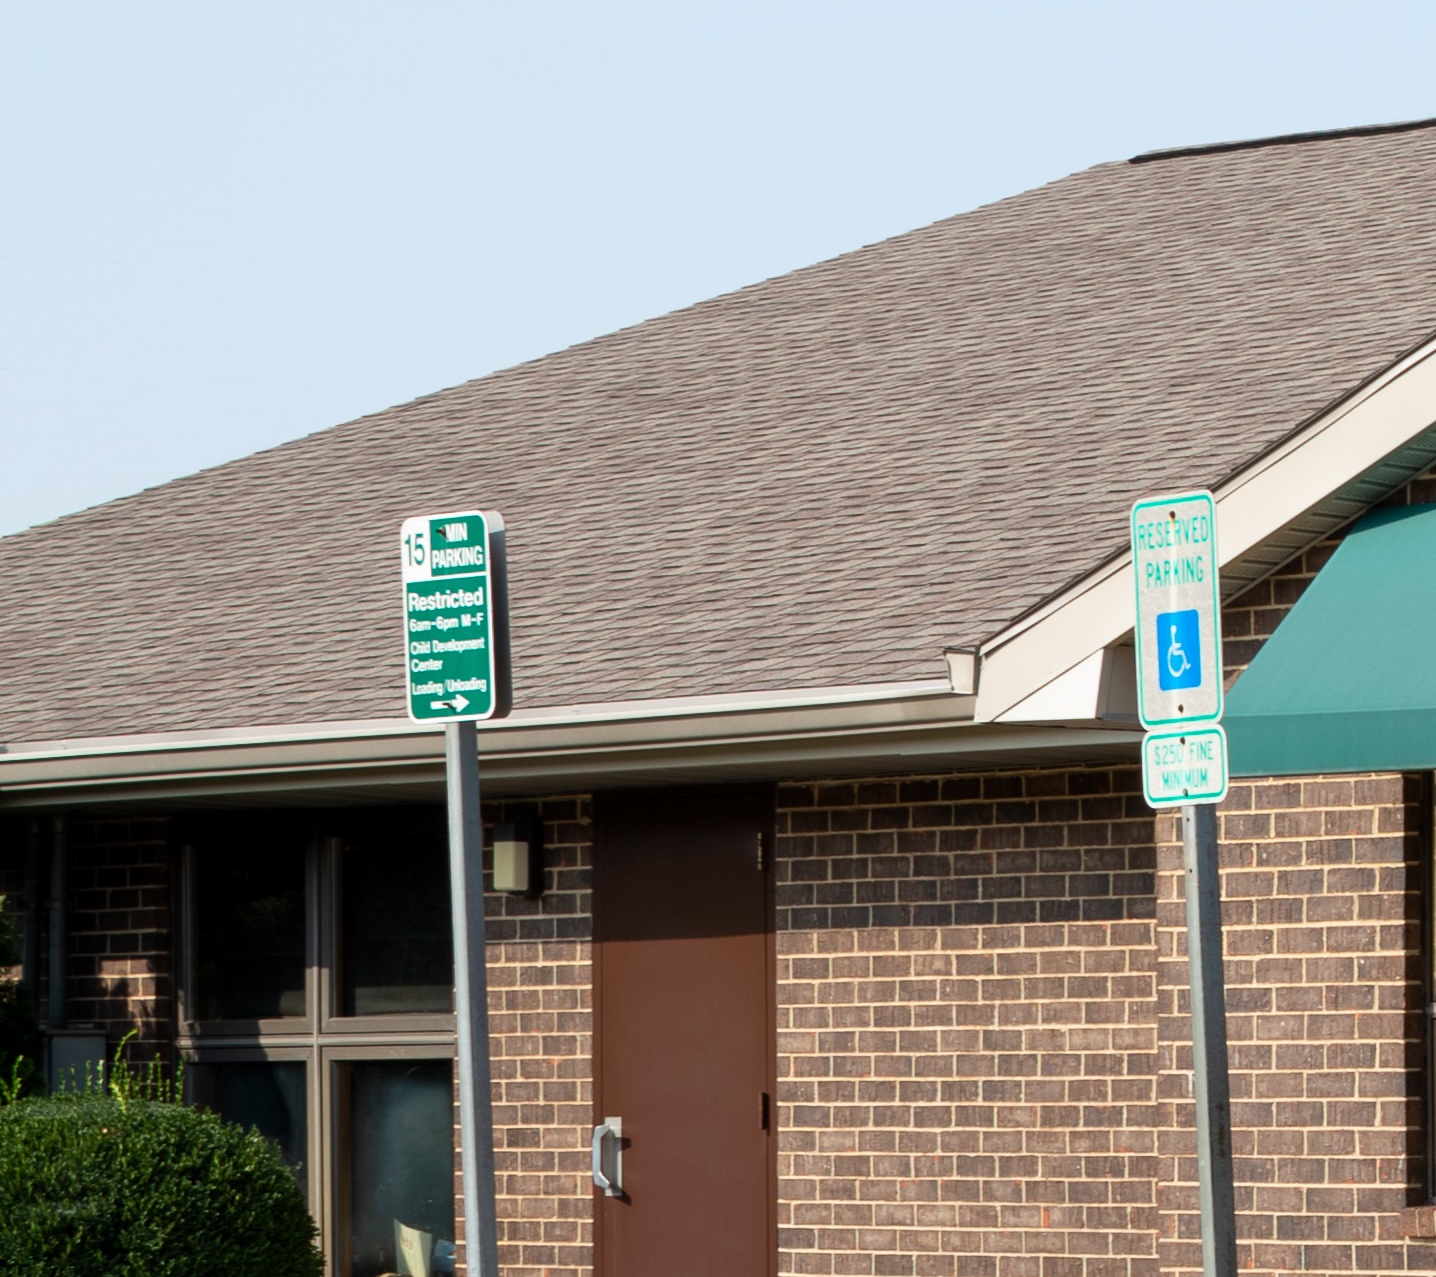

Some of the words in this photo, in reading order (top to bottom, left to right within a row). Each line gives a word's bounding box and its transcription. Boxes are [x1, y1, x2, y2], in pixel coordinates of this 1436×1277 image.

[445, 523, 467, 542] MIN
[1139, 516, 1209, 551] RESERVED
[405, 533, 425, 566] 15
[432, 547, 483, 569] PARKING
[1146, 556, 1204, 588] PARKING
[408, 587, 483, 612] Restricted
[461, 613, 484, 628] M-F
[411, 641, 431, 655] Child
[433, 637, 485, 655] Development
[411, 659, 443, 673] Center
[1154, 742, 1184, 767] $250
[1189, 741, 1214, 763] FINE
[1162, 769, 1209, 791] MINIMUM
